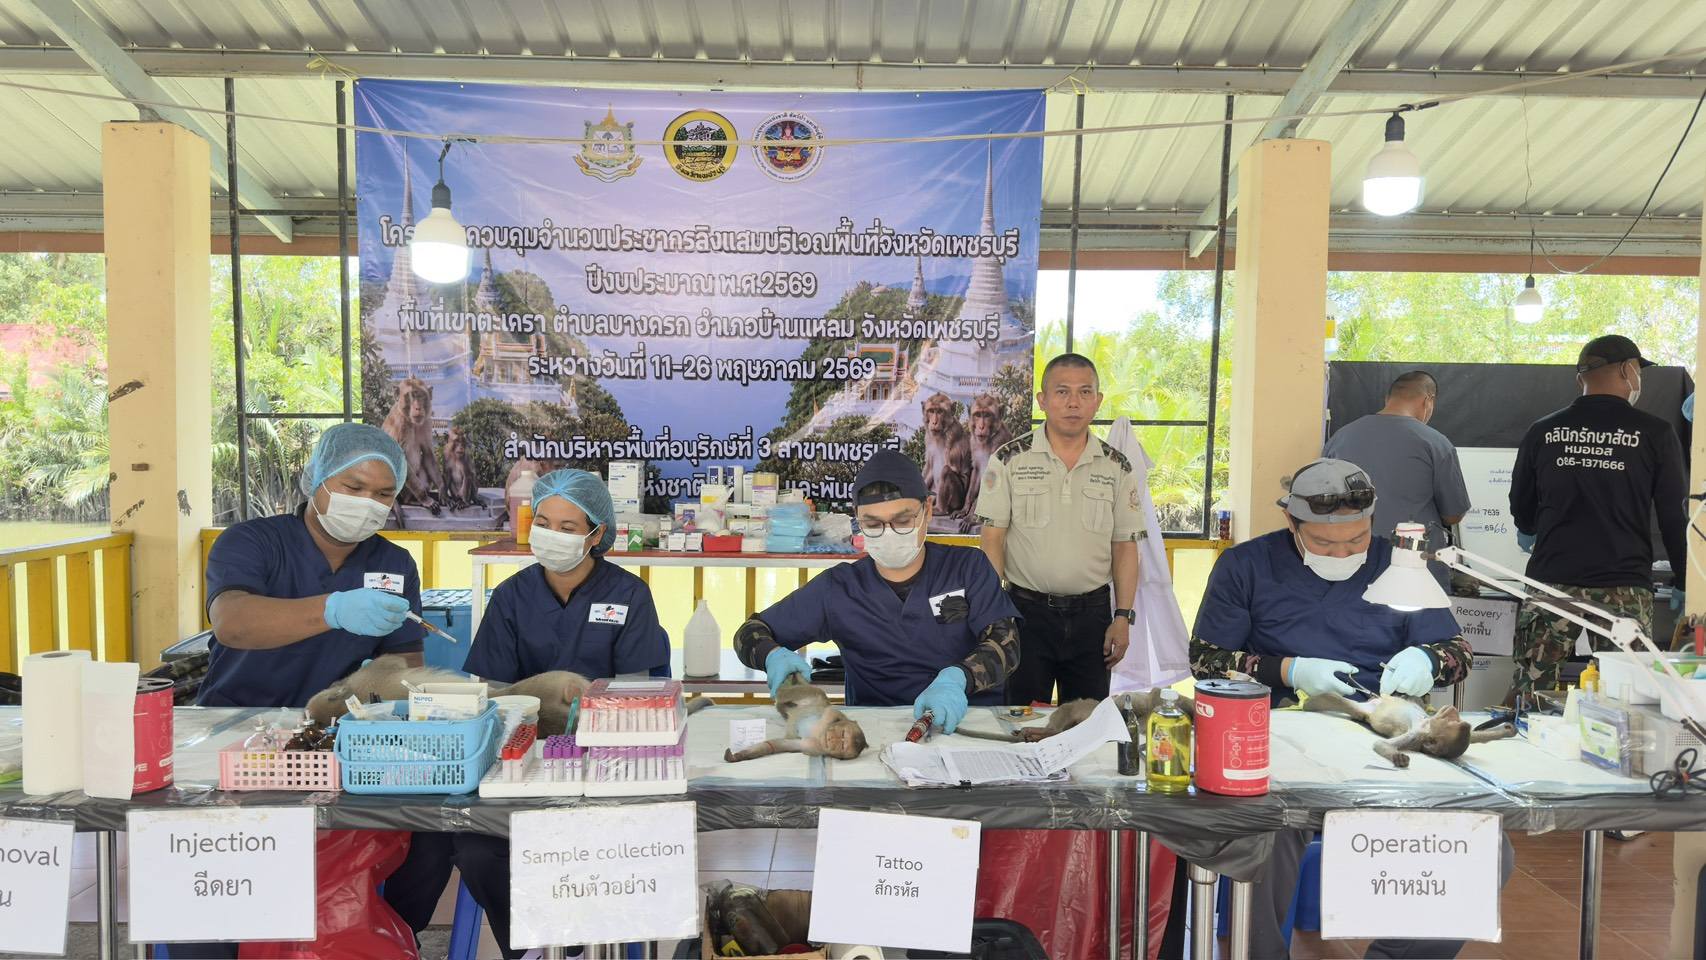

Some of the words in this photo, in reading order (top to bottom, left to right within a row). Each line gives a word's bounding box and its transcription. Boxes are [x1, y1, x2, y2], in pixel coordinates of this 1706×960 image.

[379, 215, 1018, 263] โครควบคุมจำนวนประชากรลิงแสมบริเวณพื้นที่จังหวัดเพชรบุรี
[586, 262, 714, 296] ปีงบประมาณ
[719, 271, 817, 297] พ.ศ.2569
[398, 297, 546, 334] พื้นที่เขาตะเครา
[553, 305, 689, 337] ตำบลบางครก
[696, 307, 855, 339] อำเภอบ้านแหลม
[862, 312, 1000, 348] จังหวัดเพชรบุรี
[528, 342, 646, 378] ระหว่างวันที่
[651, 355, 711, 380] 11-26
[717, 357, 816, 386] พฤษภาคม
[822, 356, 878, 380] 2569
[504, 424, 753, 464] สำนักบริหารพื้นที่อนุรักษ์ที่
[758, 437, 772, 459] 3
[778, 436, 900, 463] สาขาเพชรี
[1545, 427, 1641, 448] คลินิกรักษาสัตว์
[1564, 445, 1613, 456] หมอเอส
[1556, 456, 1625, 470] 086-1371666
[1456, 606, 1502, 620] Recovery
[170, 832, 276, 858] Injection
[522, 848, 590, 866] Sample
[596, 841, 685, 860] collection
[1351, 832, 1468, 858] Operation
[875, 855, 923, 872] Tattoo
[193, 871, 252, 897] ฉีดยา
[552, 874, 656, 899] เก็บตัวอย่าง
[874, 878, 920, 899] สักรหัส
[1371, 870, 1446, 897] ทำหมัน
